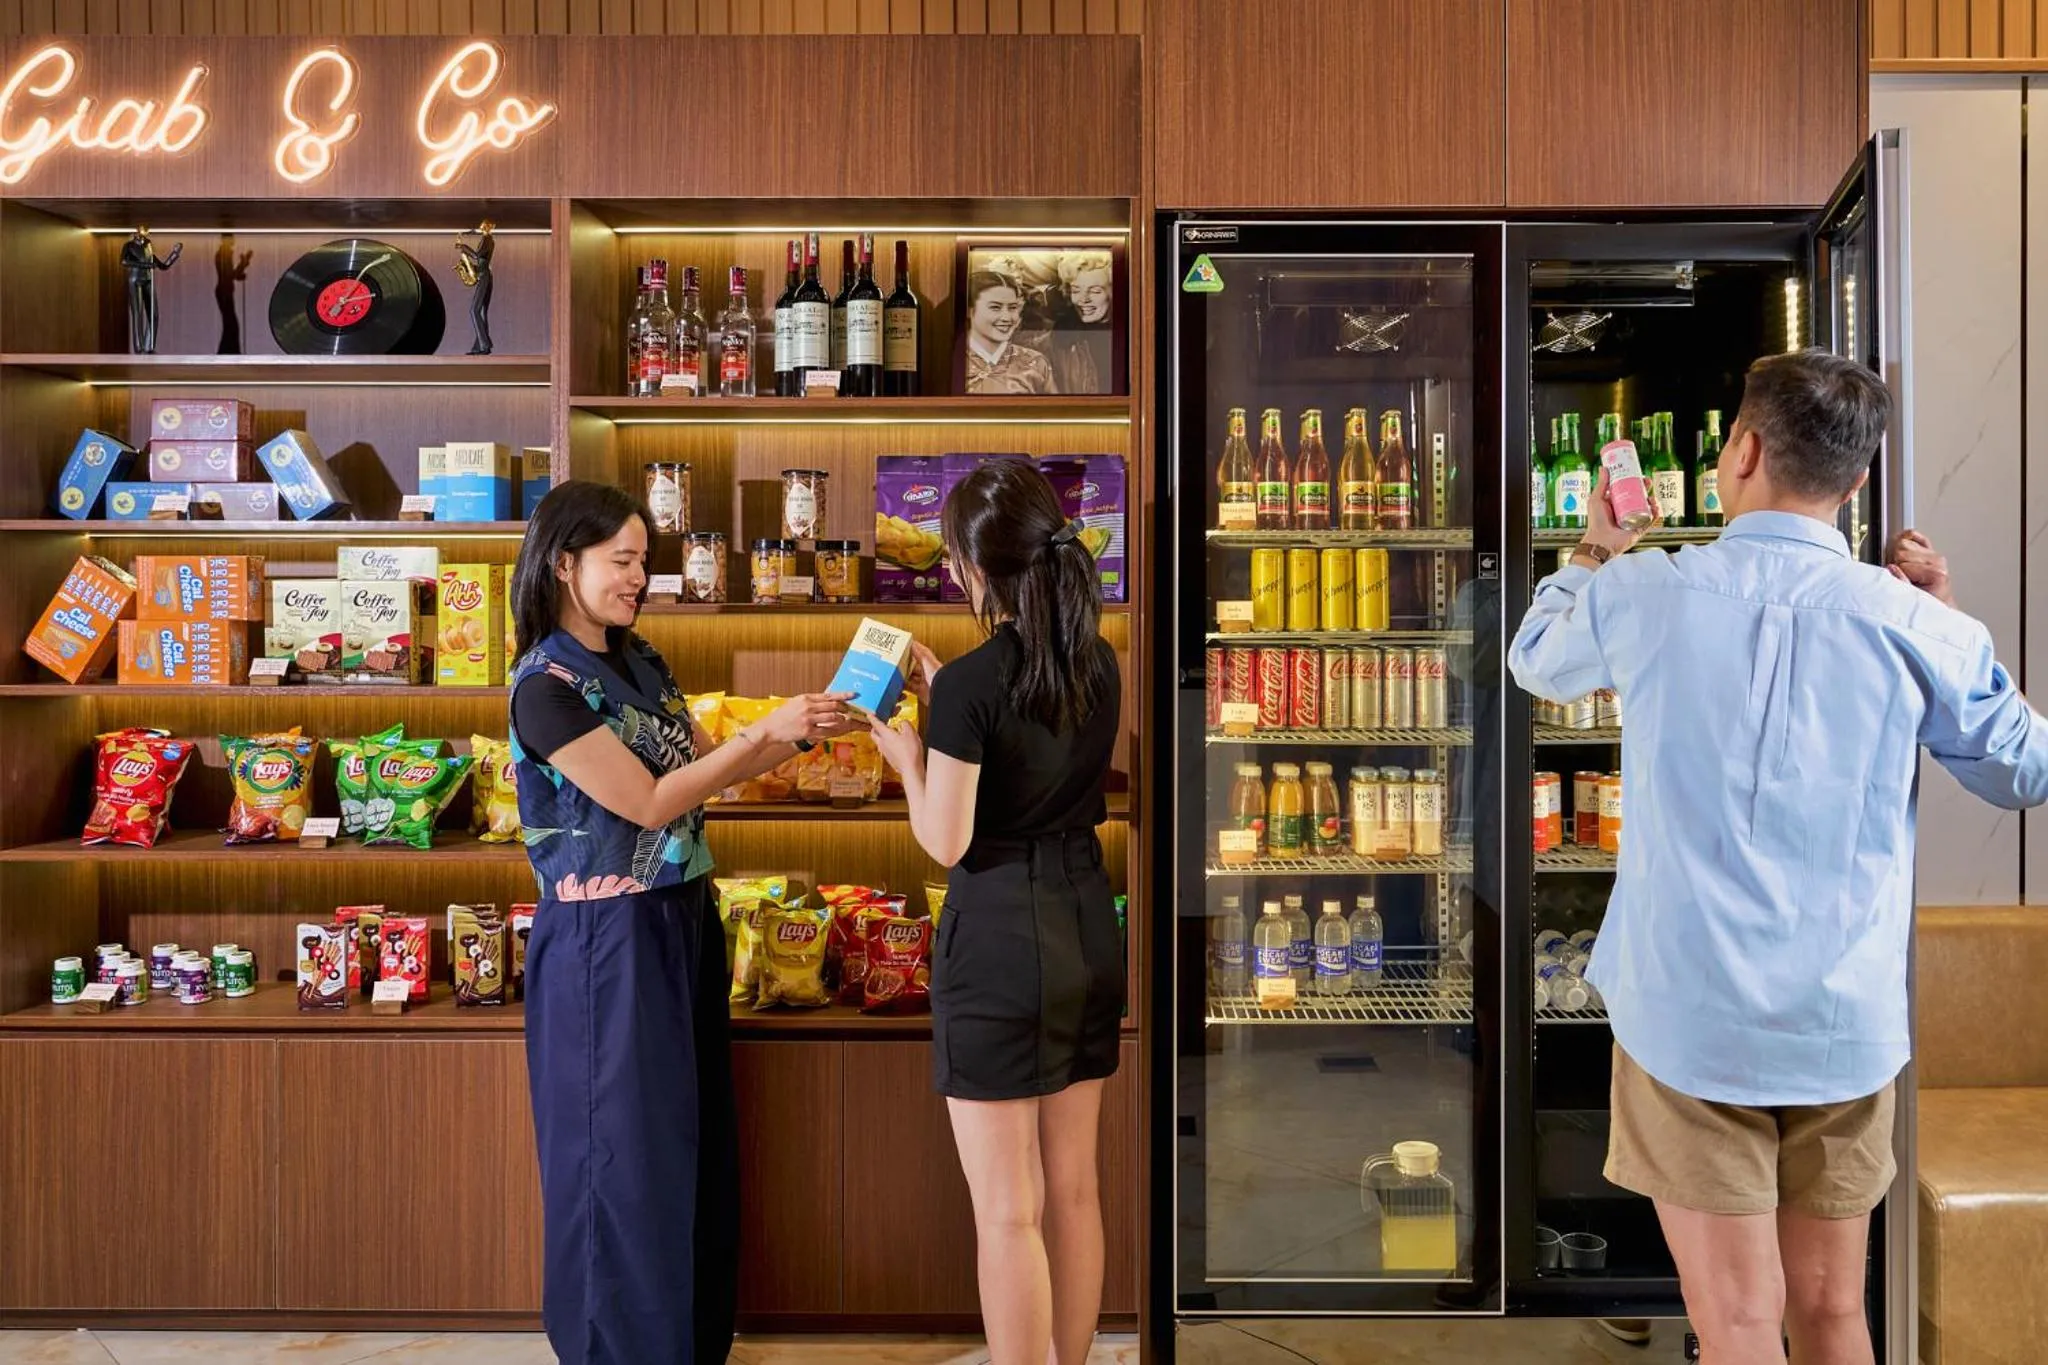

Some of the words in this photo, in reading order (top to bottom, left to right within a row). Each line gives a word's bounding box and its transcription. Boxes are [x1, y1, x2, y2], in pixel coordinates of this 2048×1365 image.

[0, 46, 208, 184] Grab
[274, 48, 360, 184] &
[417, 40, 557, 186] Go
[285, 589, 327, 607] Coffee
[353, 589, 396, 607] Coffee
[301, 605, 329, 621] Joy
[370, 605, 397, 622] Joy
